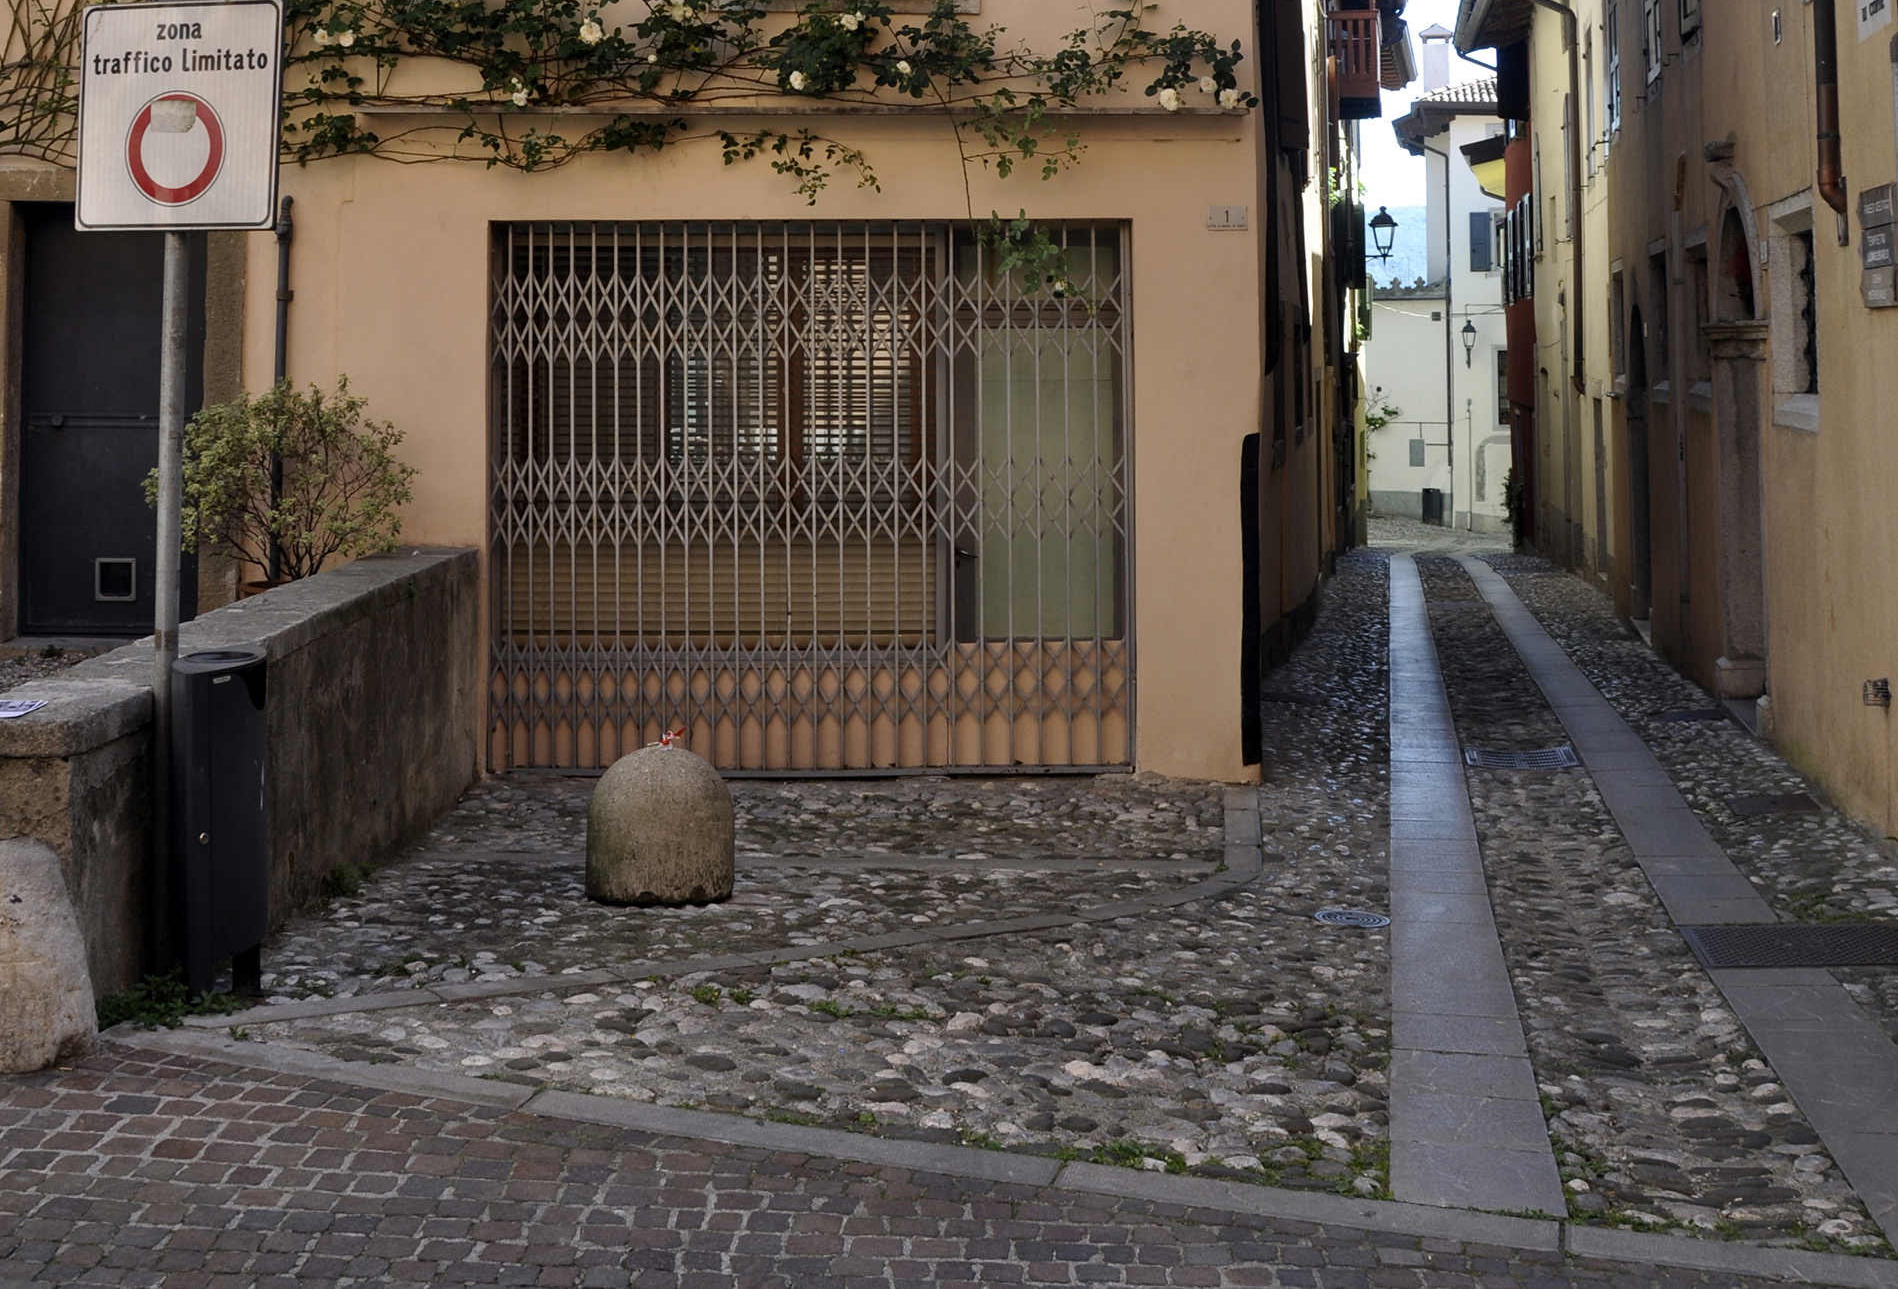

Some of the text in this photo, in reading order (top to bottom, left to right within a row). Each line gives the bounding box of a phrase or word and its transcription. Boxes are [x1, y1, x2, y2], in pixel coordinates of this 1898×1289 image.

[156, 22, 202, 40] zona
[93, 48, 268, 75] traffico limitato
[1225, 210, 1229, 223] 1
